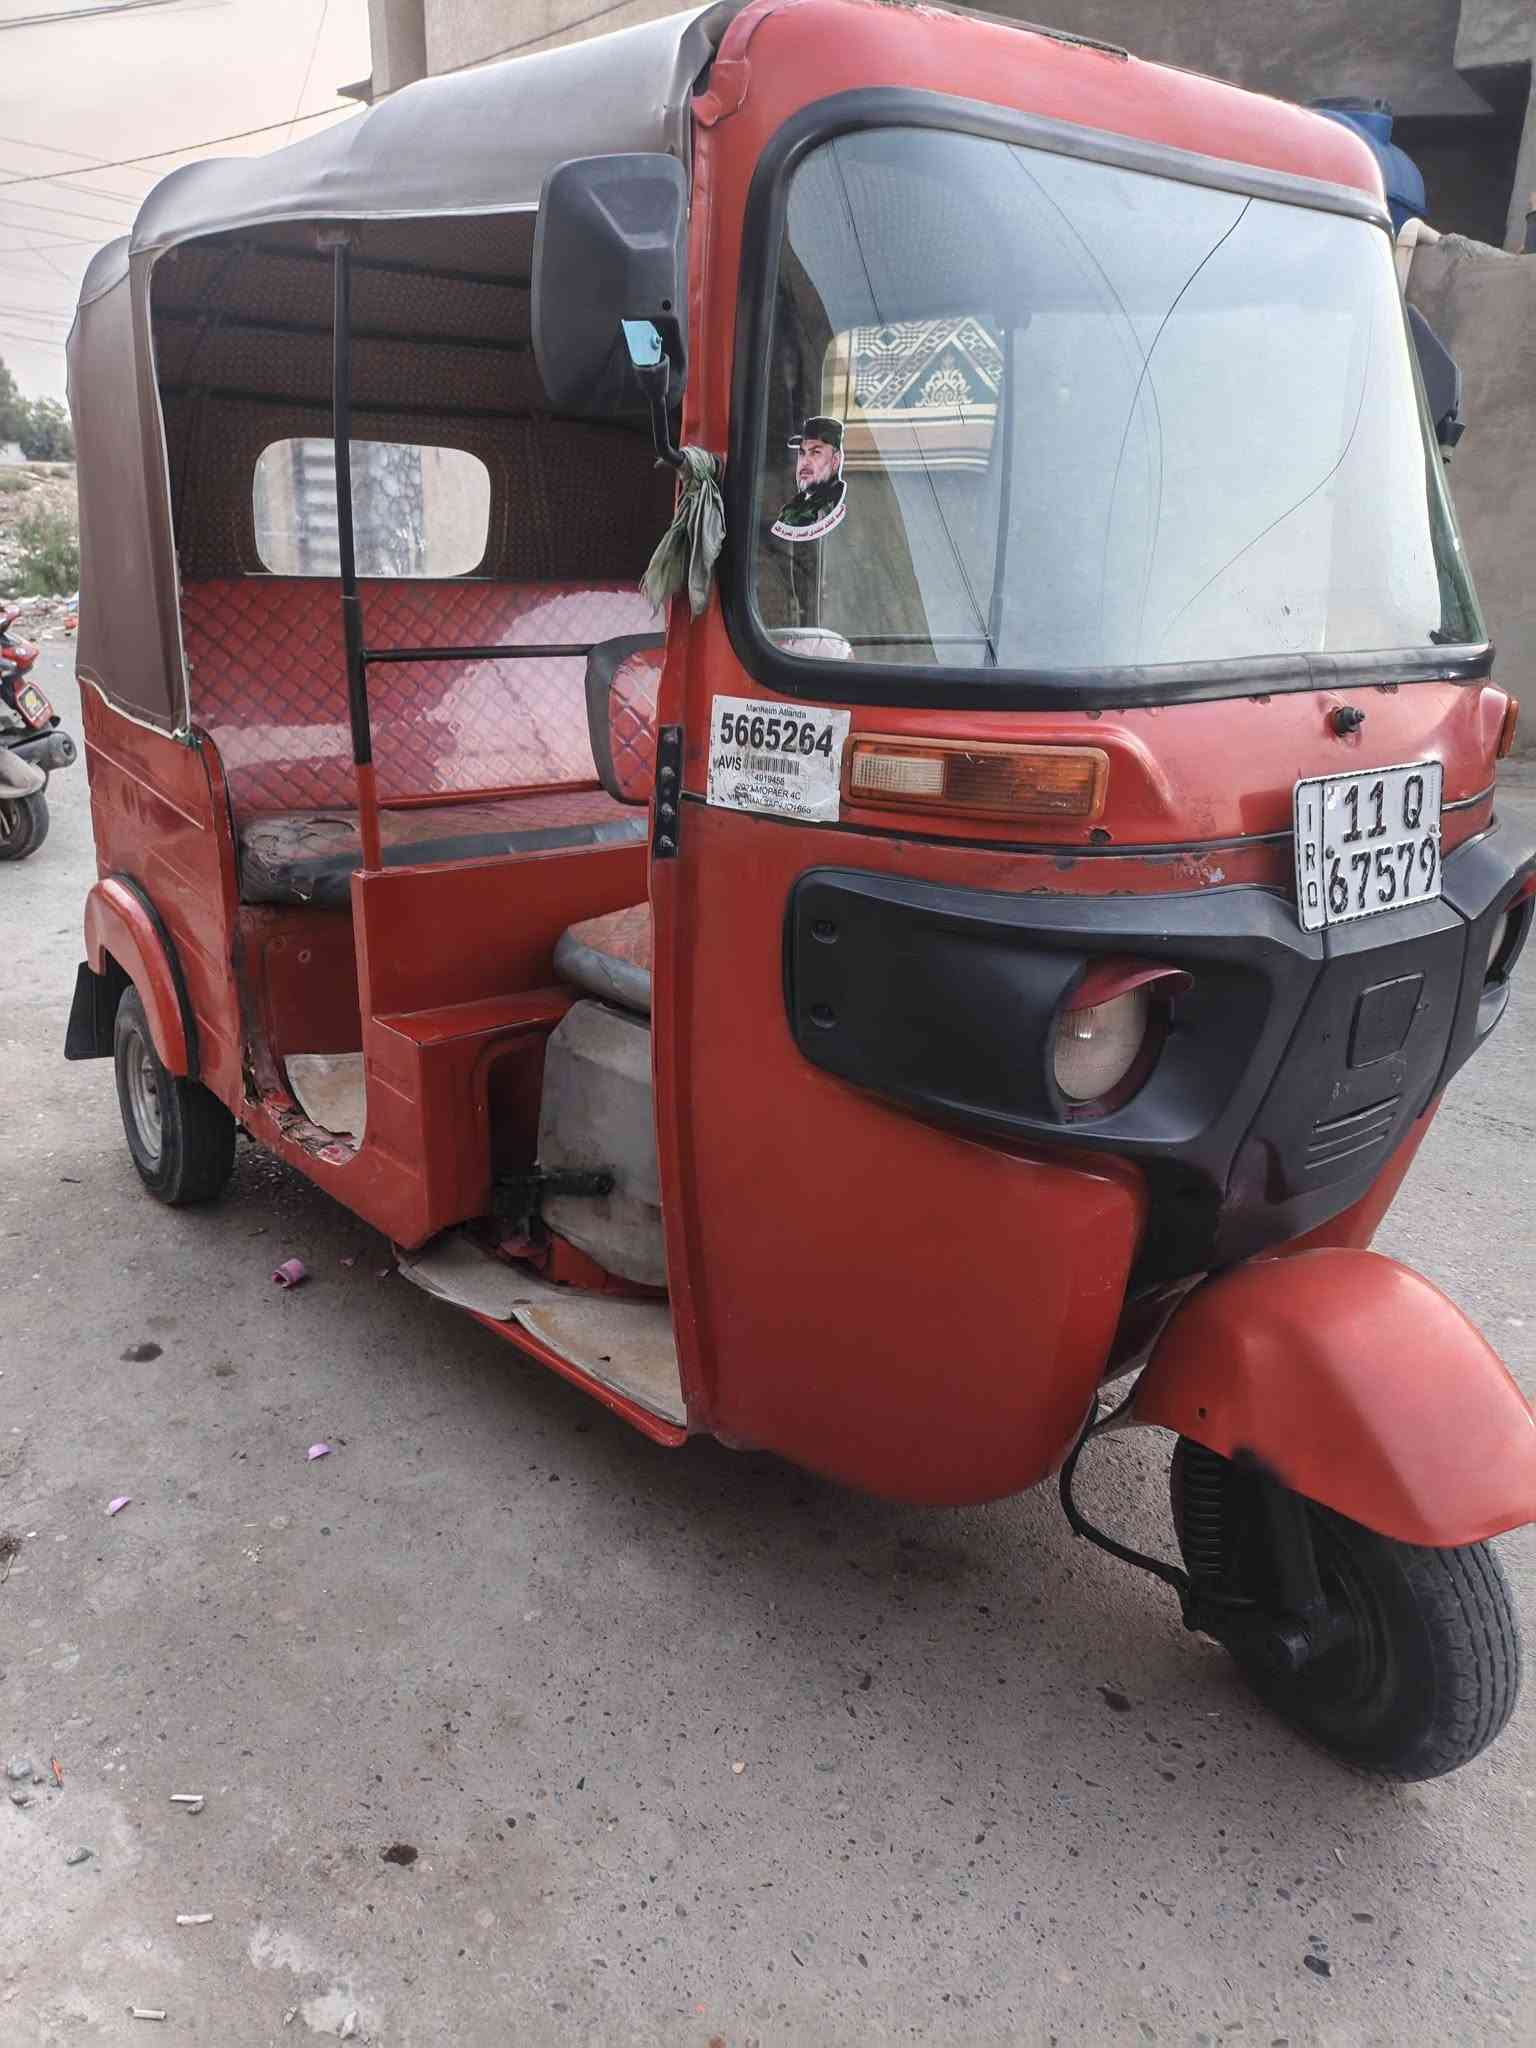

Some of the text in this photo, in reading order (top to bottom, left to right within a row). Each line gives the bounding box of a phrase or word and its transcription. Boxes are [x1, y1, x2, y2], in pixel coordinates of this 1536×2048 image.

[718, 755, 742, 771] AVIS
[720, 712, 833, 757] 5665264
[1343, 780, 1387, 843] 11
[1402, 774, 1424, 830] Q
[1305, 803, 1318, 907] IRQ
[1328, 837, 1436, 914] 67579
